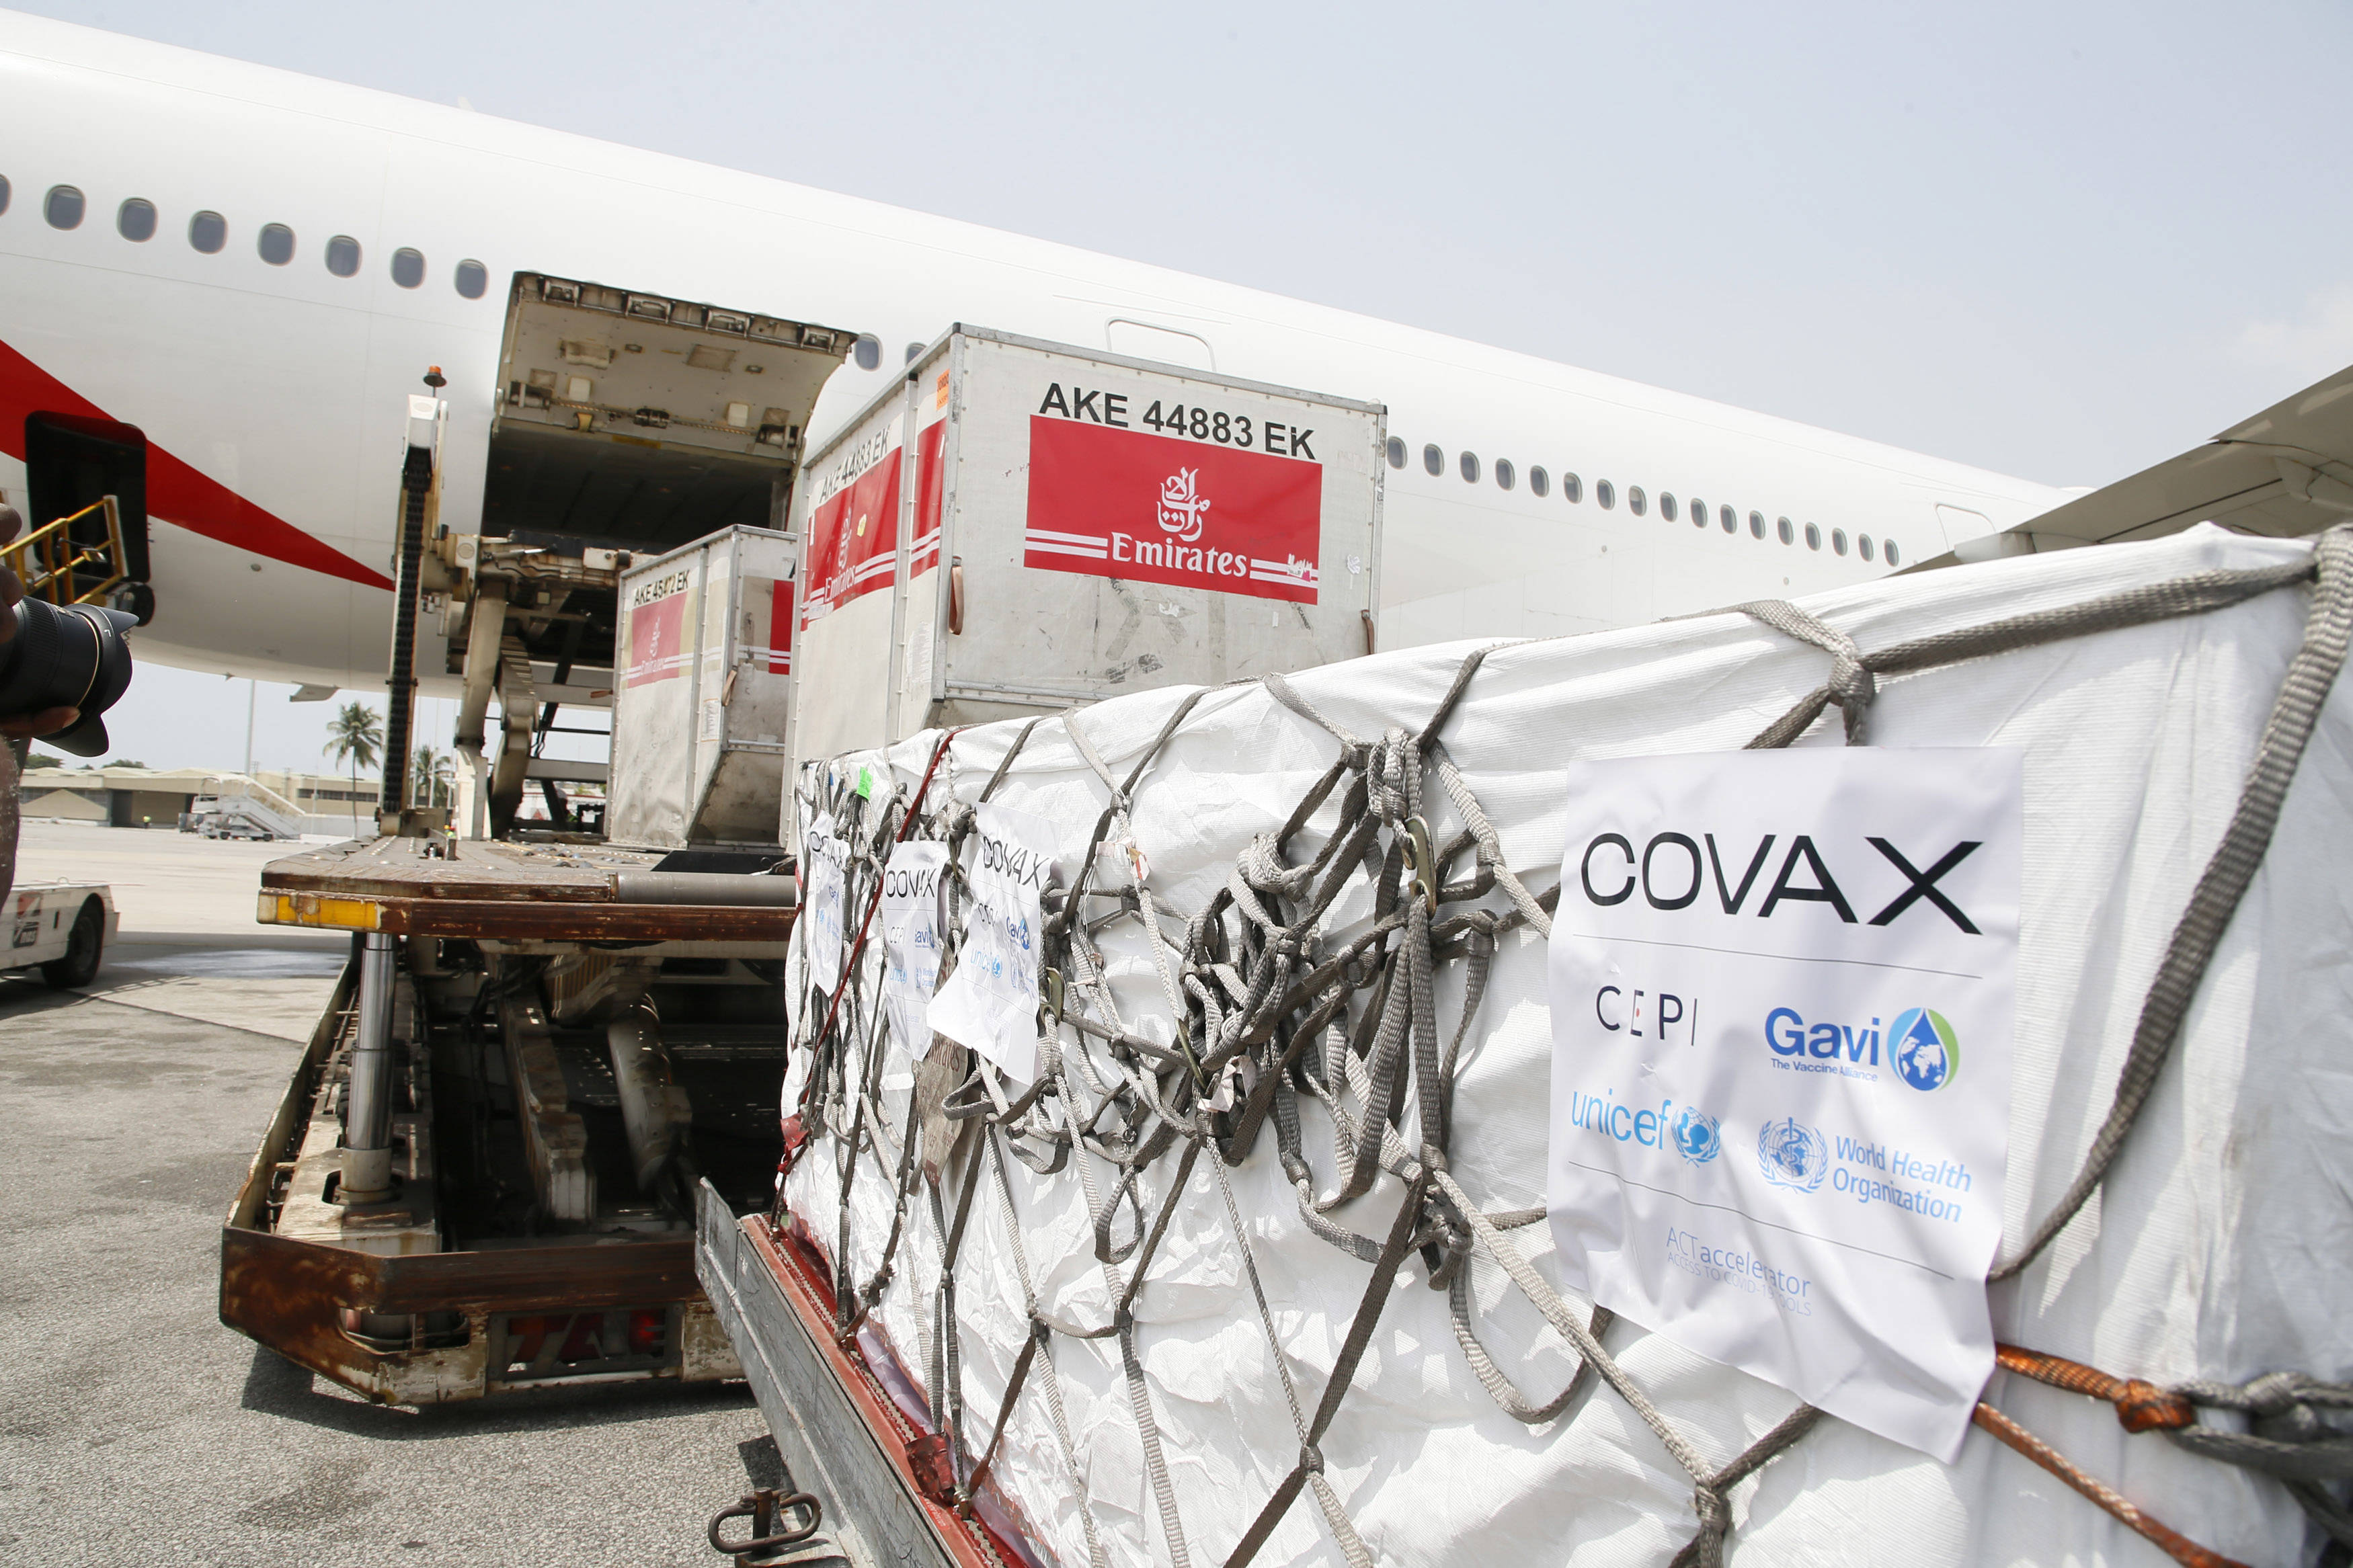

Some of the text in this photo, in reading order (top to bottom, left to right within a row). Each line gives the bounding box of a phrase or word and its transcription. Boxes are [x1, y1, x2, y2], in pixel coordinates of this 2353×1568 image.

[1039, 382, 1316, 460] AKE 44883 EK
[819, 423, 891, 504] AKE 44883 EK
[1111, 531, 1248, 578] Emirates
[634, 583, 652, 607] AKE
[676, 569, 690, 591] EK
[983, 835, 1049, 891] COVAX
[1580, 831, 1985, 936] COVAX
[1596, 985, 1698, 1046] CEPI
[1765, 1006, 1881, 1067] Gavi
[1771, 1057, 1878, 1082] The Vaccine Alliance
[1571, 1087, 1672, 1151] unicef
[1835, 1134, 1972, 1193] World Health
[1833, 1167, 1963, 1223] Organization
[1667, 1251, 1702, 1277] ACCESS
[1705, 1265, 1720, 1281] TO
